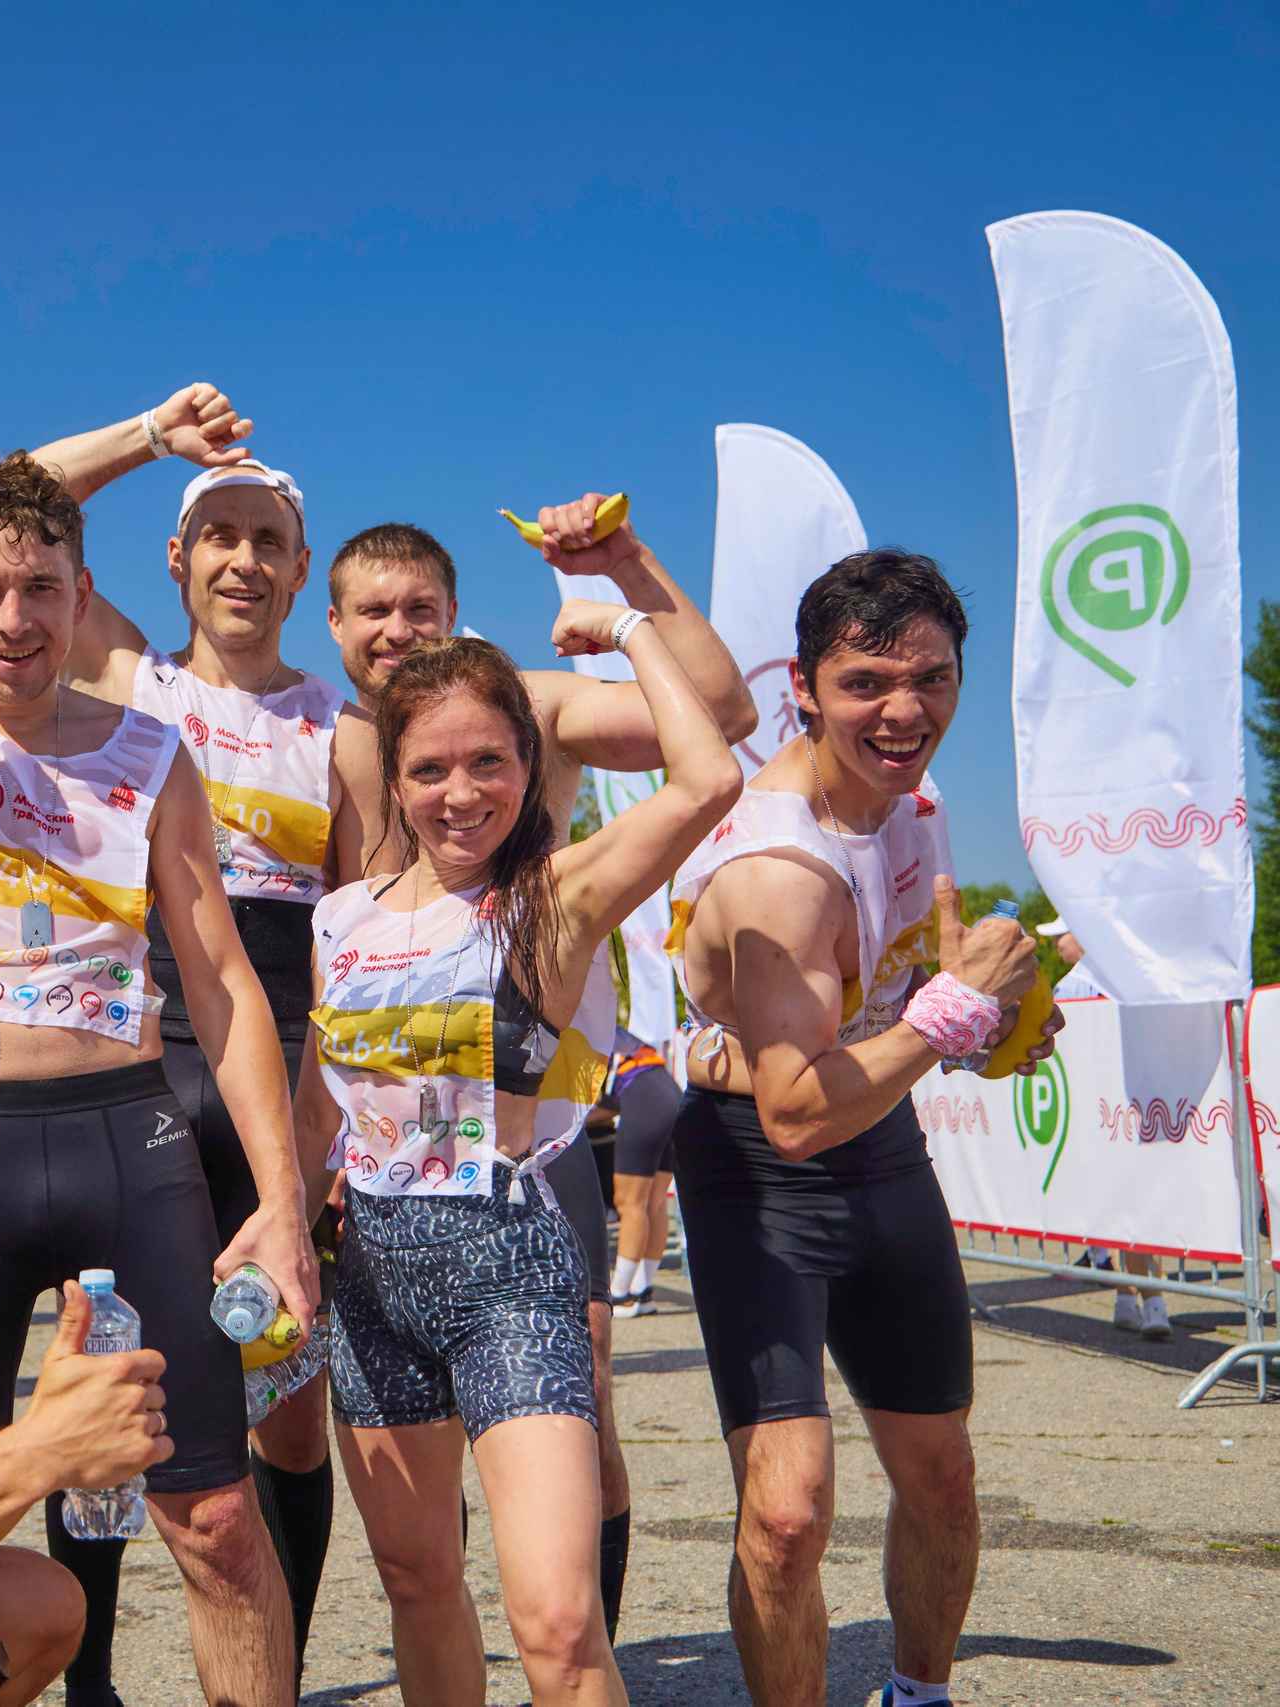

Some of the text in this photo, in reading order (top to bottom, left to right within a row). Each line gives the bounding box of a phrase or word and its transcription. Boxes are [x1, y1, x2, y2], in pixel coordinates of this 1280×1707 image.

[214, 727, 273, 750] Москвский
[12, 807, 61, 836] трапорт
[360, 961, 413, 974] транспорт
[1031, 1075, 1053, 1130] P
[146, 1128, 189, 1149] DEMIX
